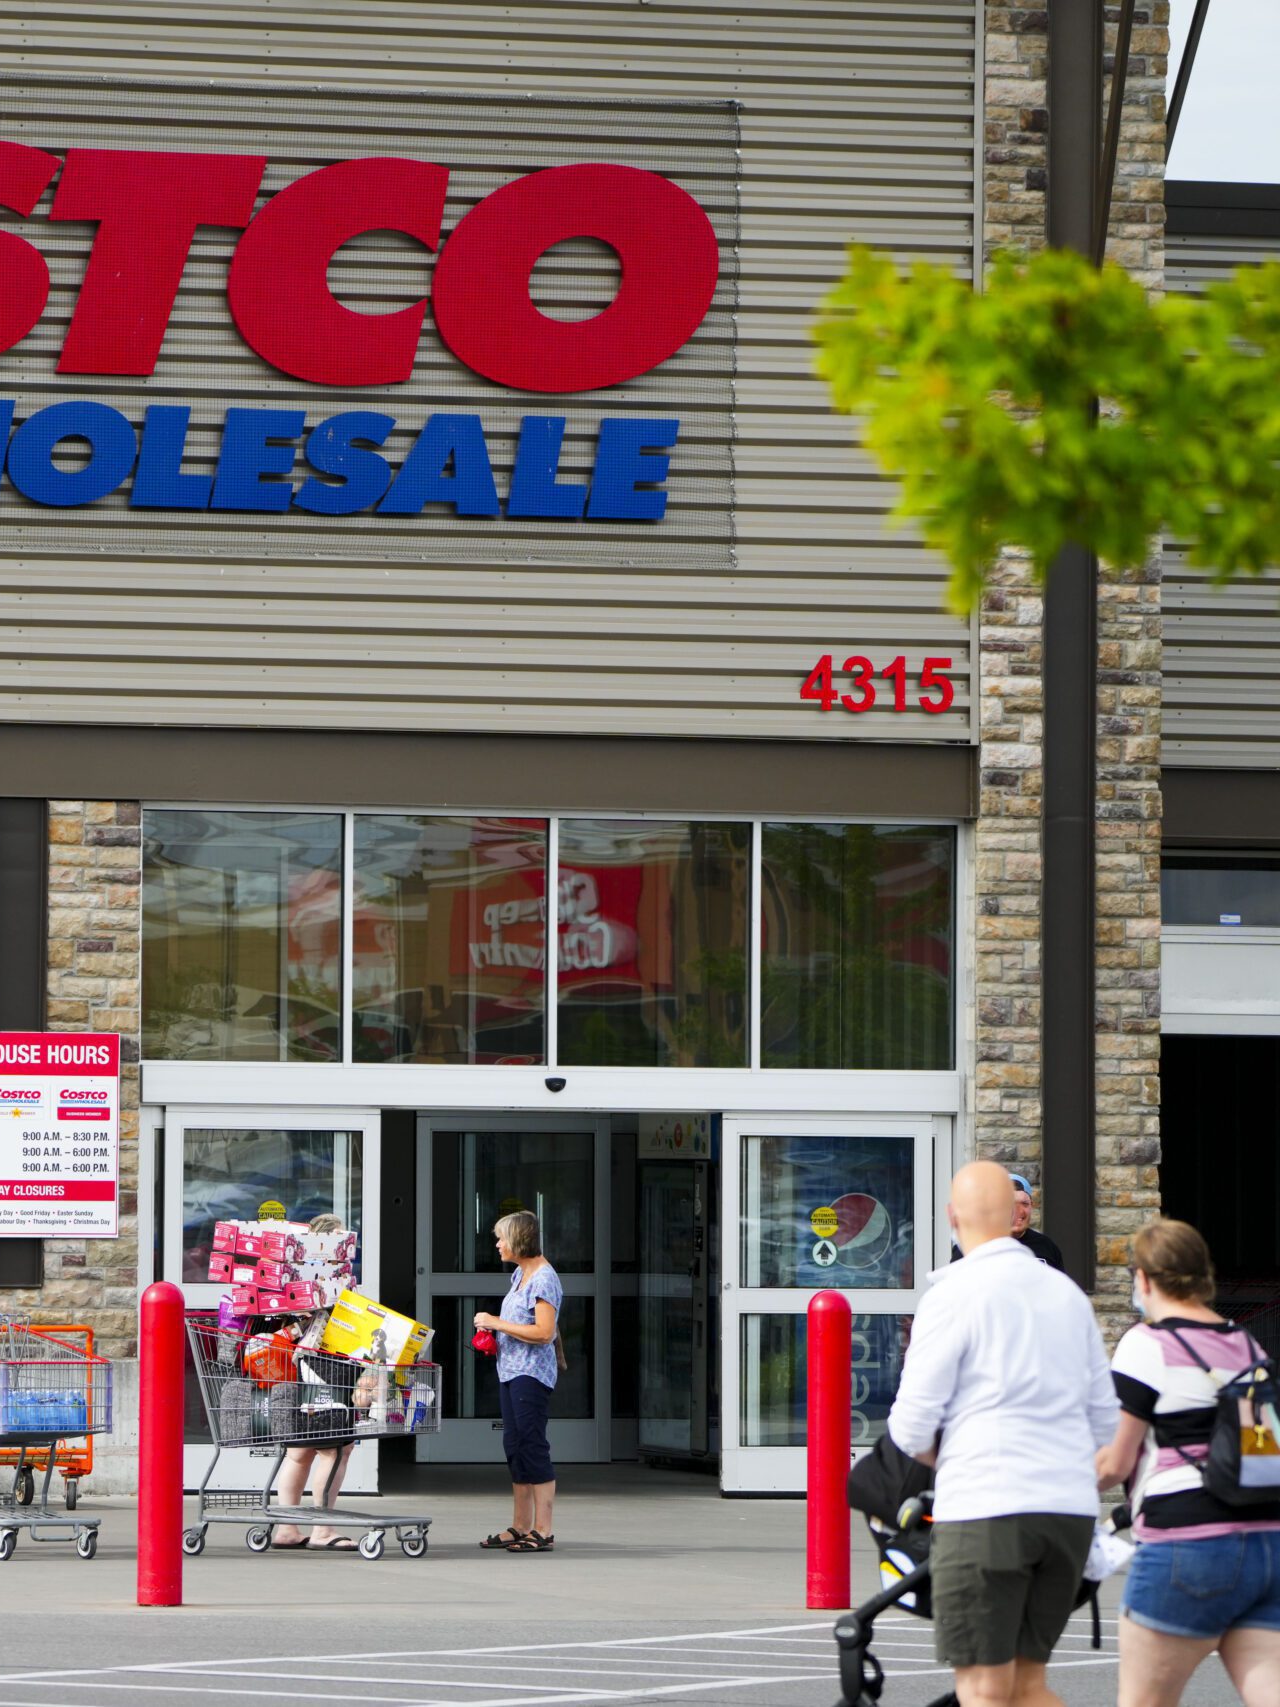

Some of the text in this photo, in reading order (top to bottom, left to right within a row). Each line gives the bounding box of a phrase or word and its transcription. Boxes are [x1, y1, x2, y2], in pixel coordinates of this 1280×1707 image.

[800, 655, 953, 713] 4315
[47, 1044, 110, 1065] HOURS
[60, 1089, 108, 1100] COSTCO
[22, 1132, 41, 1140] 9:00
[43, 1132, 62, 1140] A.M.
[73, 1132, 91, 1141] 8:30
[93, 1132, 110, 1141] P.M.
[22, 1148, 41, 1156] 9:00
[43, 1148, 62, 1156] A.M.
[73, 1148, 91, 1157] 6:00
[93, 1148, 110, 1157] P.M.
[22, 1163, 41, 1172] 9:00
[43, 1163, 62, 1172] A.M.
[73, 1164, 91, 1172] 6:00
[93, 1164, 110, 1172] P.M.
[13, 1185, 65, 1196] CLOSURES
